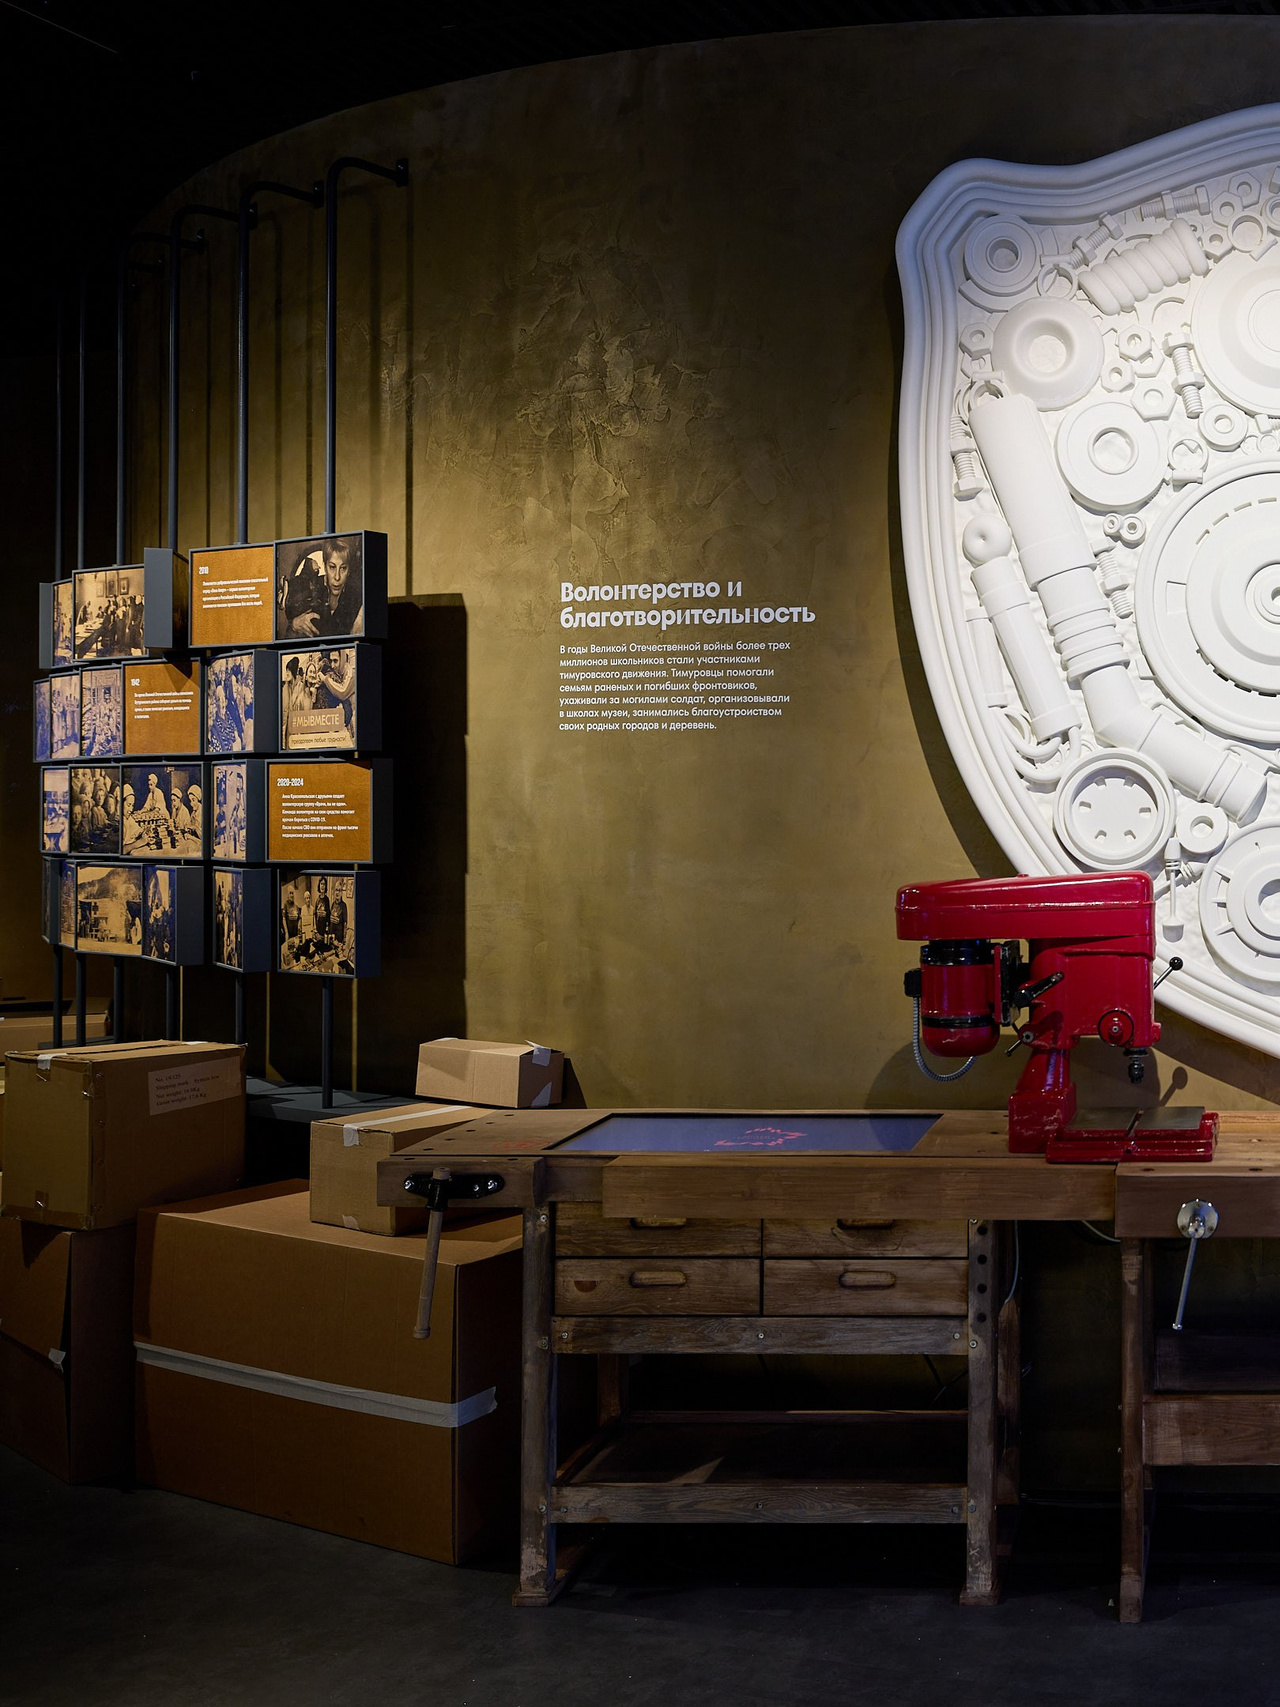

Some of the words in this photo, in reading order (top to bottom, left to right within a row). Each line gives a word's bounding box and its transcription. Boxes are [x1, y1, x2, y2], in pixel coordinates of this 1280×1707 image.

[561, 582, 720, 604] Волонтерство
[728, 582, 741, 596] и
[560, 606, 815, 629] благотворительность
[560, 645, 565, 654] В
[567, 646, 588, 655] годы
[590, 644, 627, 653] Великой
[629, 642, 700, 652] Отечественной
[704, 642, 733, 650] войны
[736, 641, 765, 650] более
[768, 643, 790, 651] трех
[697, 656, 760, 666] участниками
[559, 671, 620, 681] тимуровского
[622, 671, 669, 679] движения.
[671, 668, 723, 679] Тимуровцы
[594, 684, 634, 693] раненых
[644, 681, 690, 690] погибших
[692, 681, 757, 692] фронтовиков,
[559, 697, 607, 707] ухаживали
[708, 696, 789, 705] организовывали
[292, 714, 339, 727] #МЫВМЕСТЕ
[601, 710, 630, 719] музеи,
[587, 723, 620, 732] родных
[622, 722, 659, 731] городов
[669, 722, 717, 731] деревень.
[277, 778, 304, 786] 2020-2024
